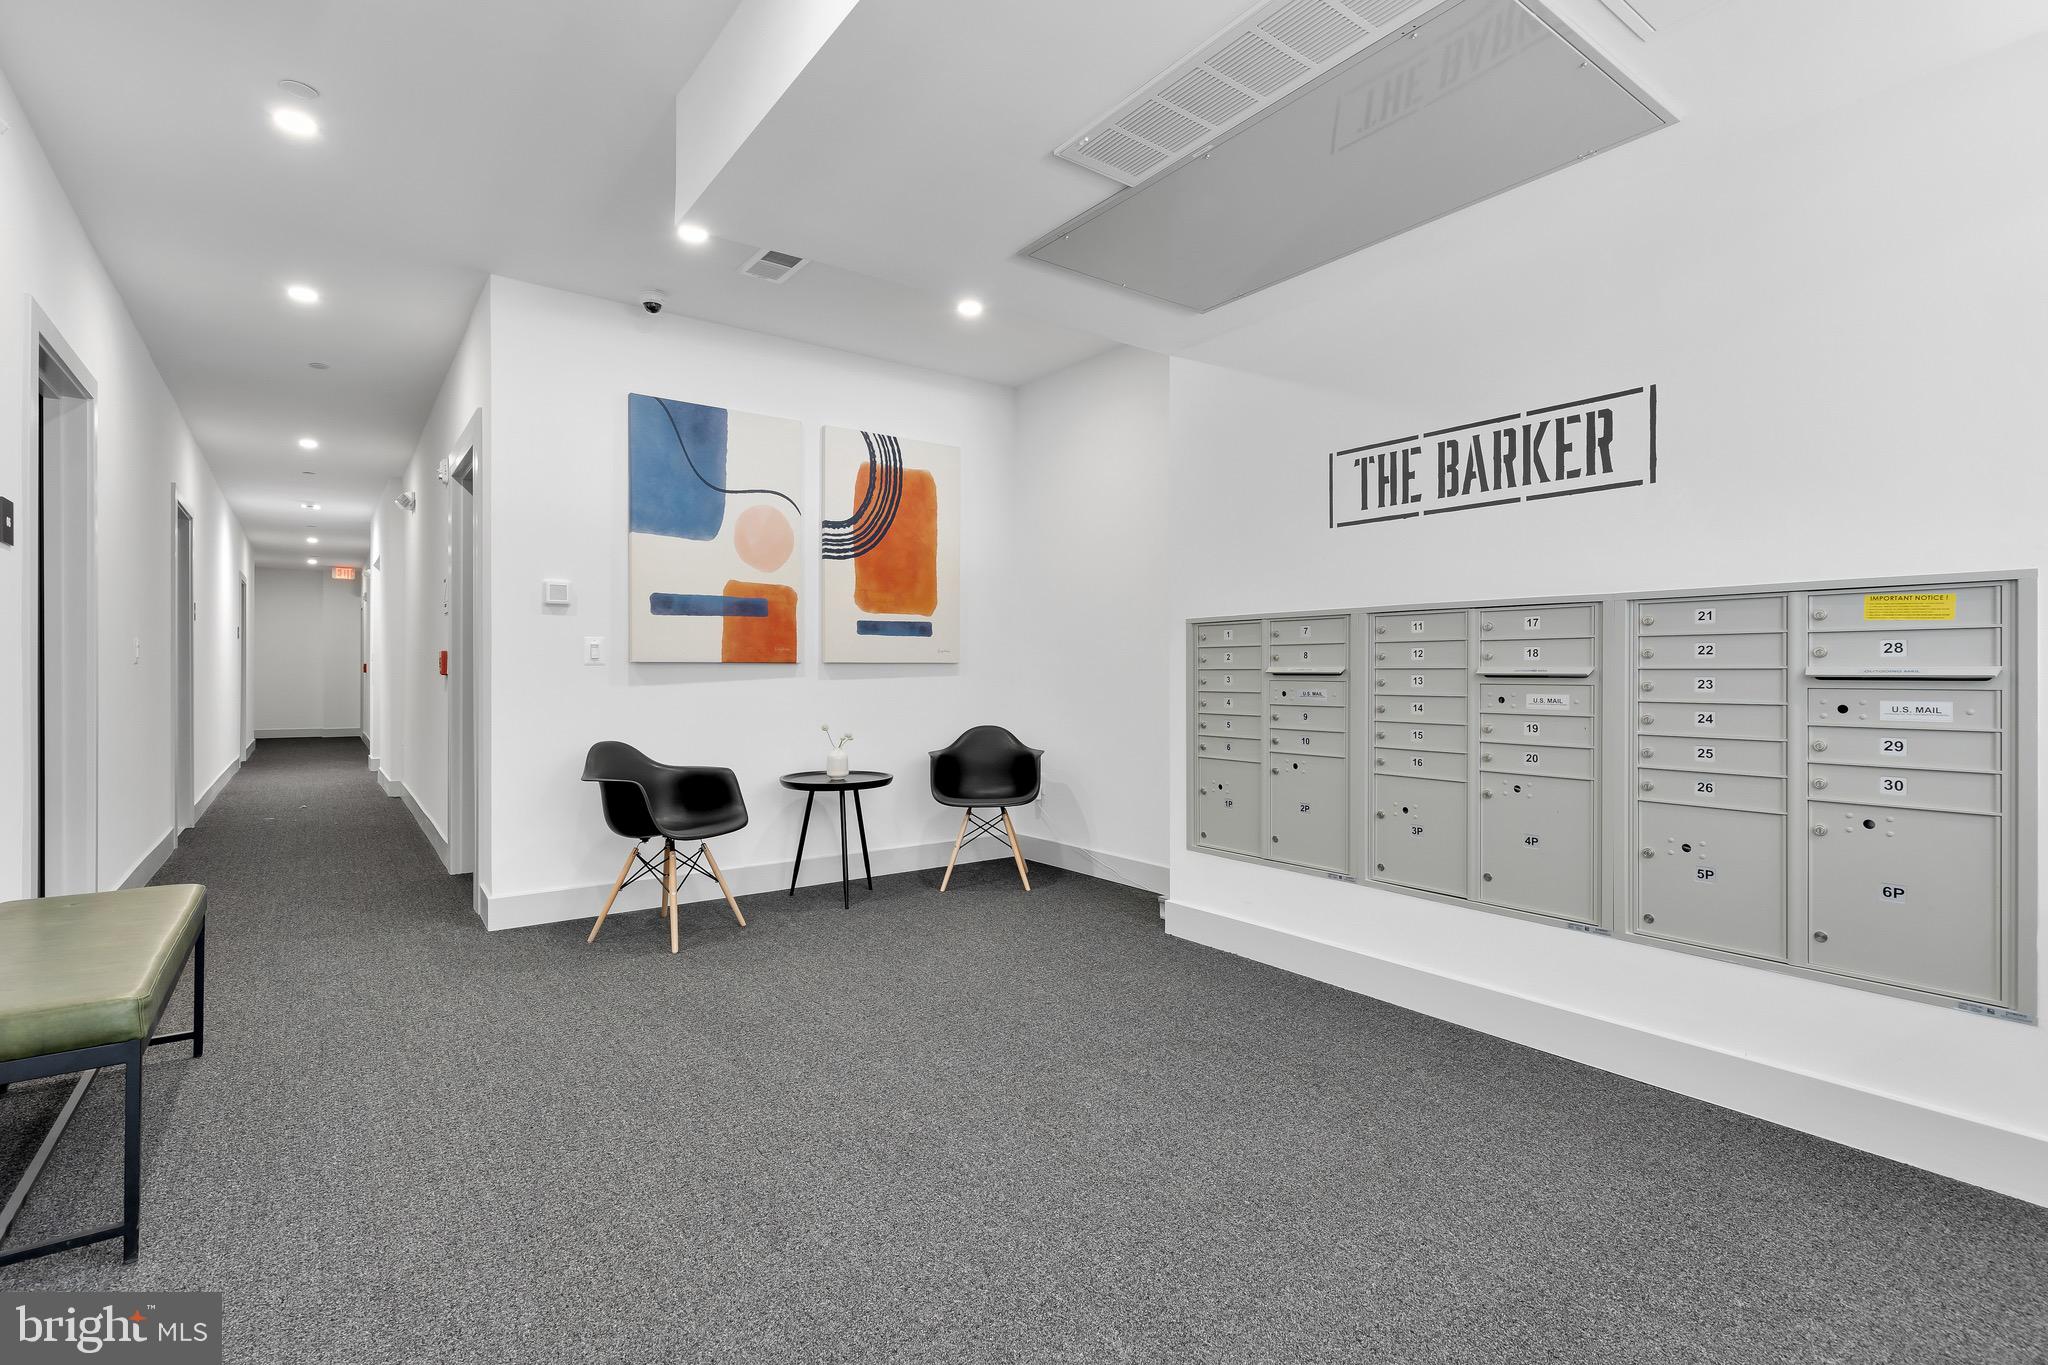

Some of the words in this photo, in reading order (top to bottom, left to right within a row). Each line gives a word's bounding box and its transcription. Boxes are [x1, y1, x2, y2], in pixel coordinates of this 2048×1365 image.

[1354, 446, 1422, 511] THE
[1437, 408, 1614, 499] BARKER
[1697, 610, 1712, 621] 21
[1413, 622, 1423, 631] 11
[1526, 618, 1539, 627] 17
[1527, 648, 1539, 658] 18
[1697, 645, 1714, 655] 22
[1883, 642, 1904, 654] 28
[1412, 649, 1423, 658] 12
[1413, 676, 1423, 685] 13
[1697, 679, 1714, 690] 23
[1413, 704, 1423, 712] 14
[1915, 706, 1942, 714] MAIL
[1697, 713, 1714, 724] 24
[1526, 723, 1539, 733] 19
[1412, 731, 1423, 740] 15
[1883, 740, 1904, 752] 29
[1526, 753, 1539, 763] 20
[1697, 748, 1714, 759] 25
[1412, 758, 1423, 767] 16
[1697, 782, 1713, 793] 26
[1883, 779, 1904, 792] 30
[1411, 826, 1424, 835] 3P
[1524, 836, 1539, 846] 4P
[1697, 868, 1714, 880] 5P
[1882, 886, 1905, 899] 6P
